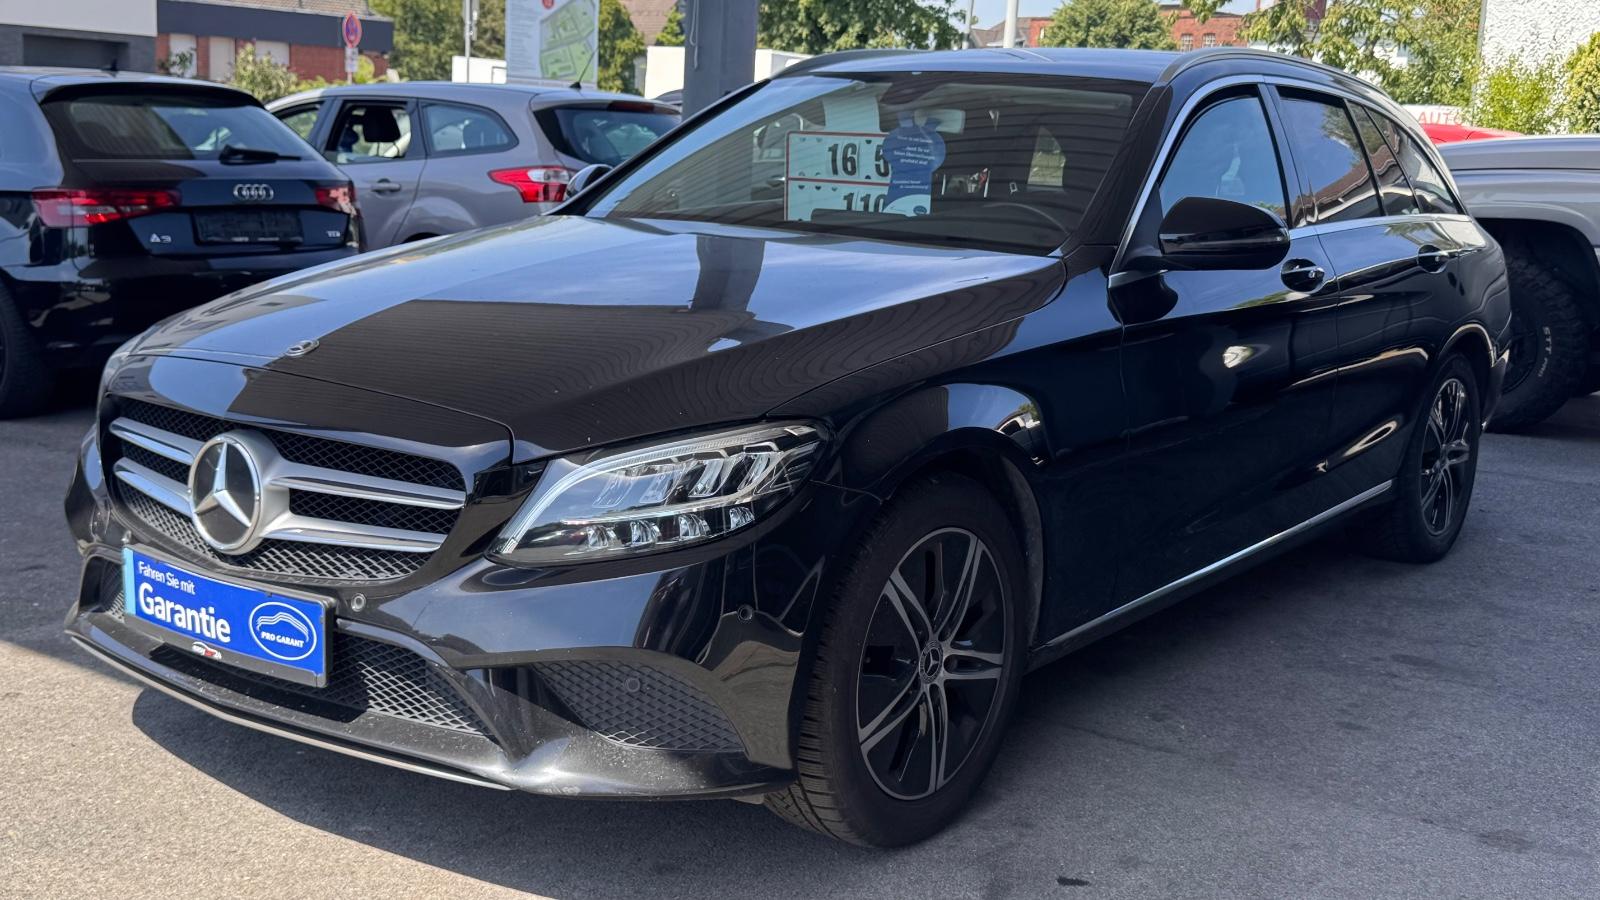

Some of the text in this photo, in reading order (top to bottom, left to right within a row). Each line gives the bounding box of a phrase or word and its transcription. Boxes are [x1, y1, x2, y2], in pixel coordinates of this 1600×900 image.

[828, 143, 890, 177] 16 5
[150, 233, 172, 243] A3
[138, 561, 196, 596] Fahren Sie mit
[139, 582, 231, 643] Garantie
[262, 632, 304, 648] PRO GARANT
